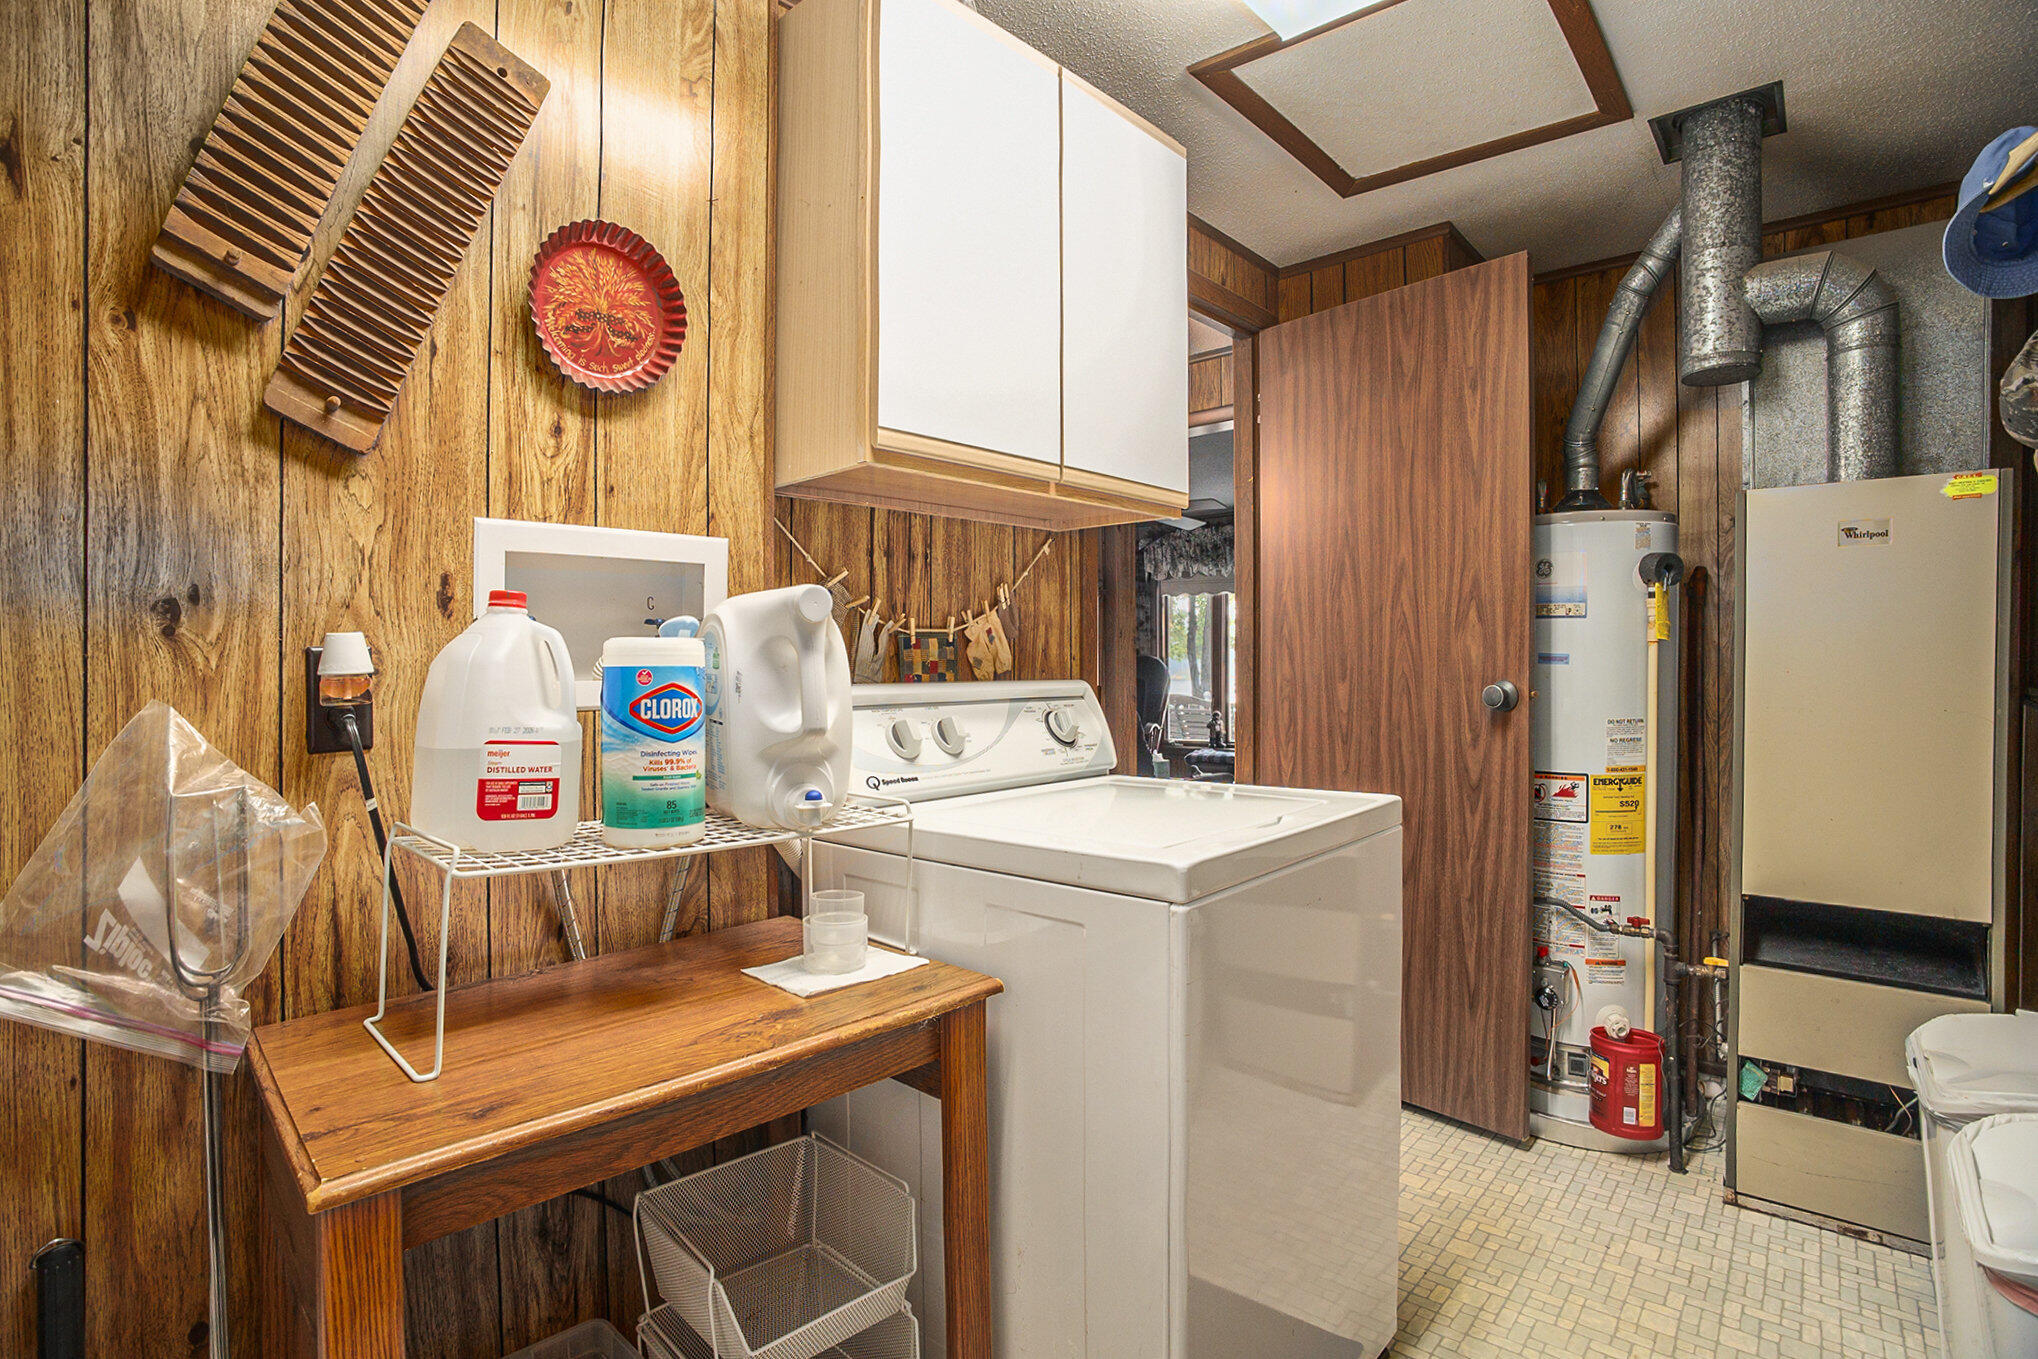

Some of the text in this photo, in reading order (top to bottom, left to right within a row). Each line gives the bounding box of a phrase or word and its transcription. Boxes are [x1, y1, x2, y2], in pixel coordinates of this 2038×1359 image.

[1845, 529, 1889, 539] Whirlpool
[640, 698, 699, 720] CLOROX
[487, 749, 511, 758] meijer
[666, 801, 677, 809] 85
